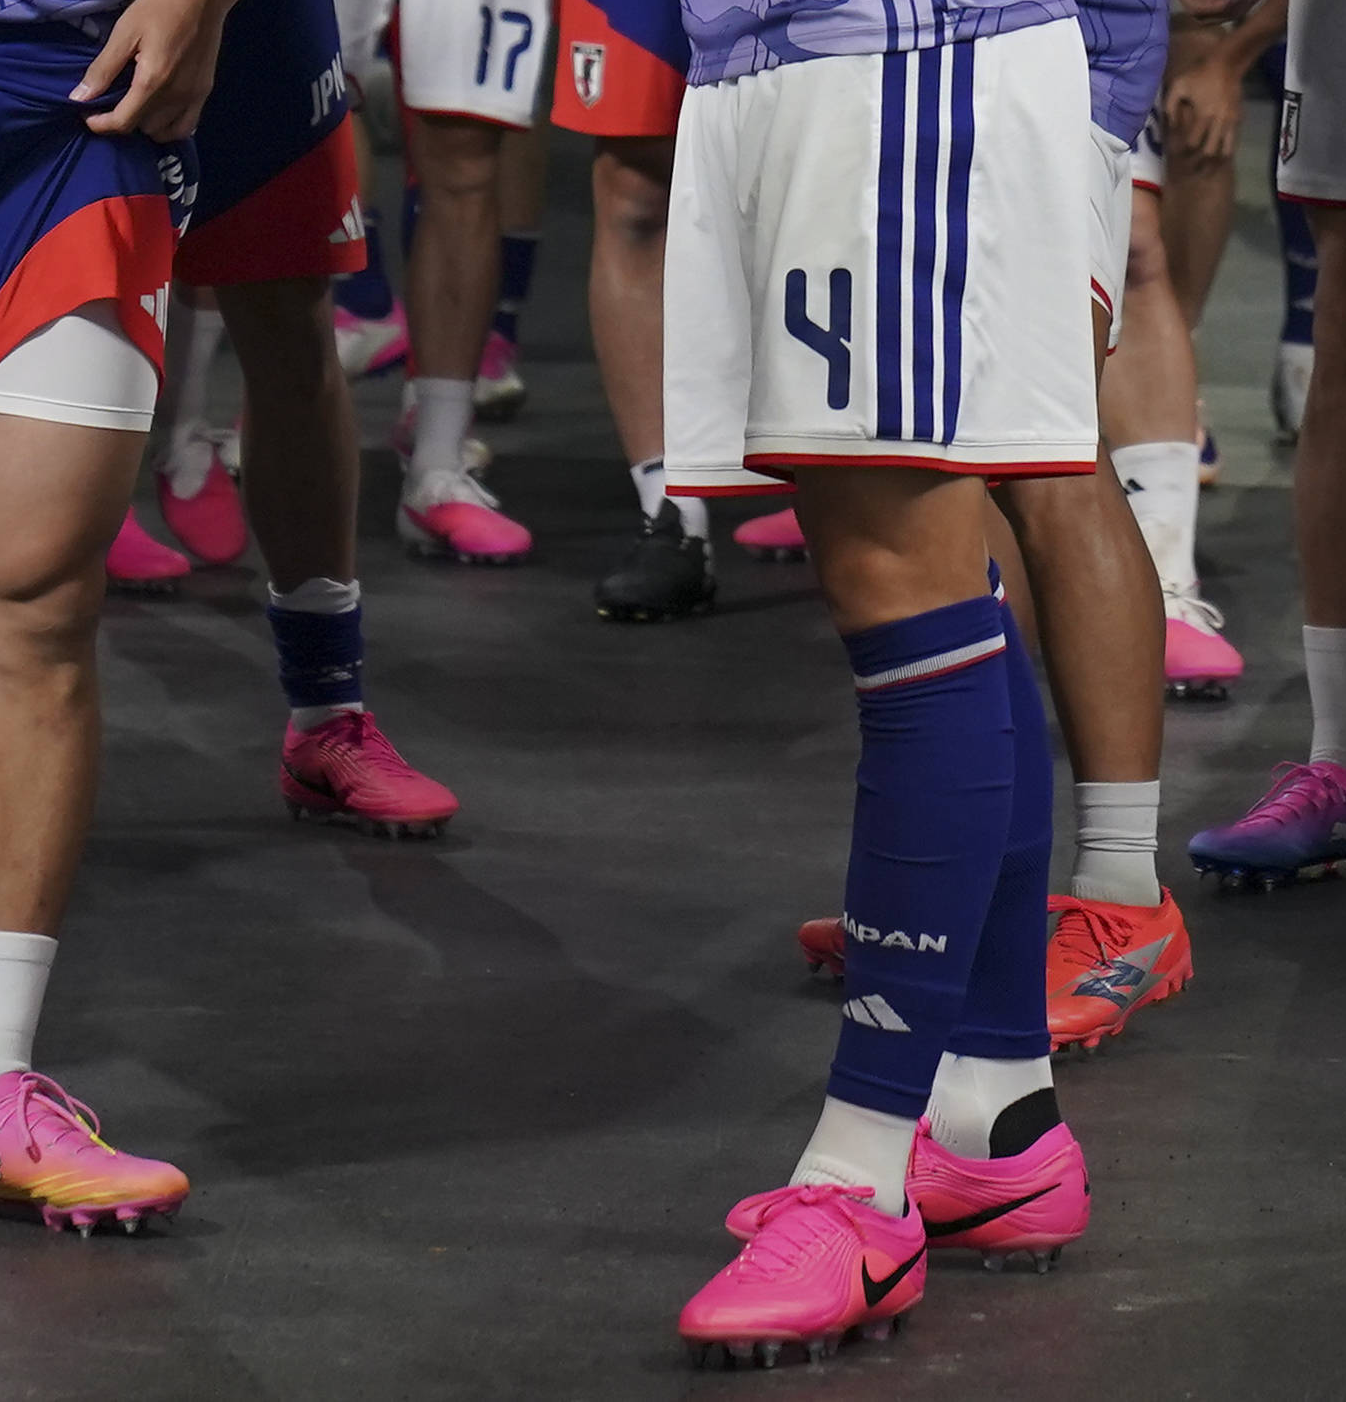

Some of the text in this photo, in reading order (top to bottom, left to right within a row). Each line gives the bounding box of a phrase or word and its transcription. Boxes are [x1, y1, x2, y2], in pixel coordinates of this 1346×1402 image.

[310, 51, 347, 127] JPN
[476, 5, 533, 92] 17
[784, 267, 853, 411] 4
